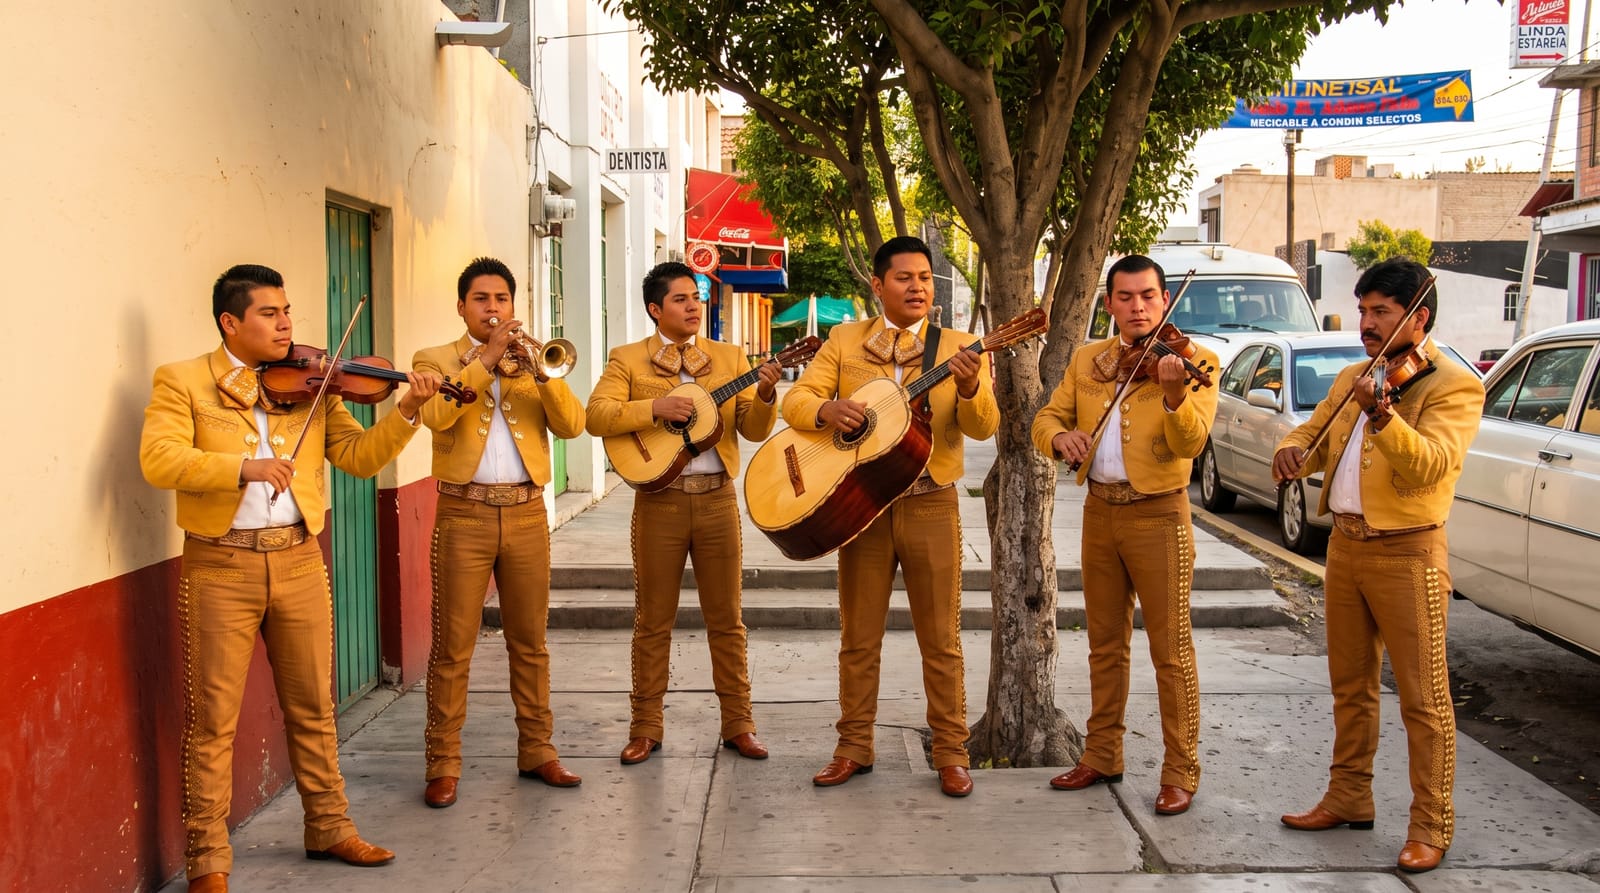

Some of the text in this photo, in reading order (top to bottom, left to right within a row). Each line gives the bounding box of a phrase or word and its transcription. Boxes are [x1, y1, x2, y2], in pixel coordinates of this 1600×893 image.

[1519, 26, 1566, 36] LINDA
[1518, 37, 1567, 48] ESTAREIA
[1250, 113, 1422, 127] MECICABLE A CONDIN SELECTOS
[609, 151, 667, 170] DENTISTA
